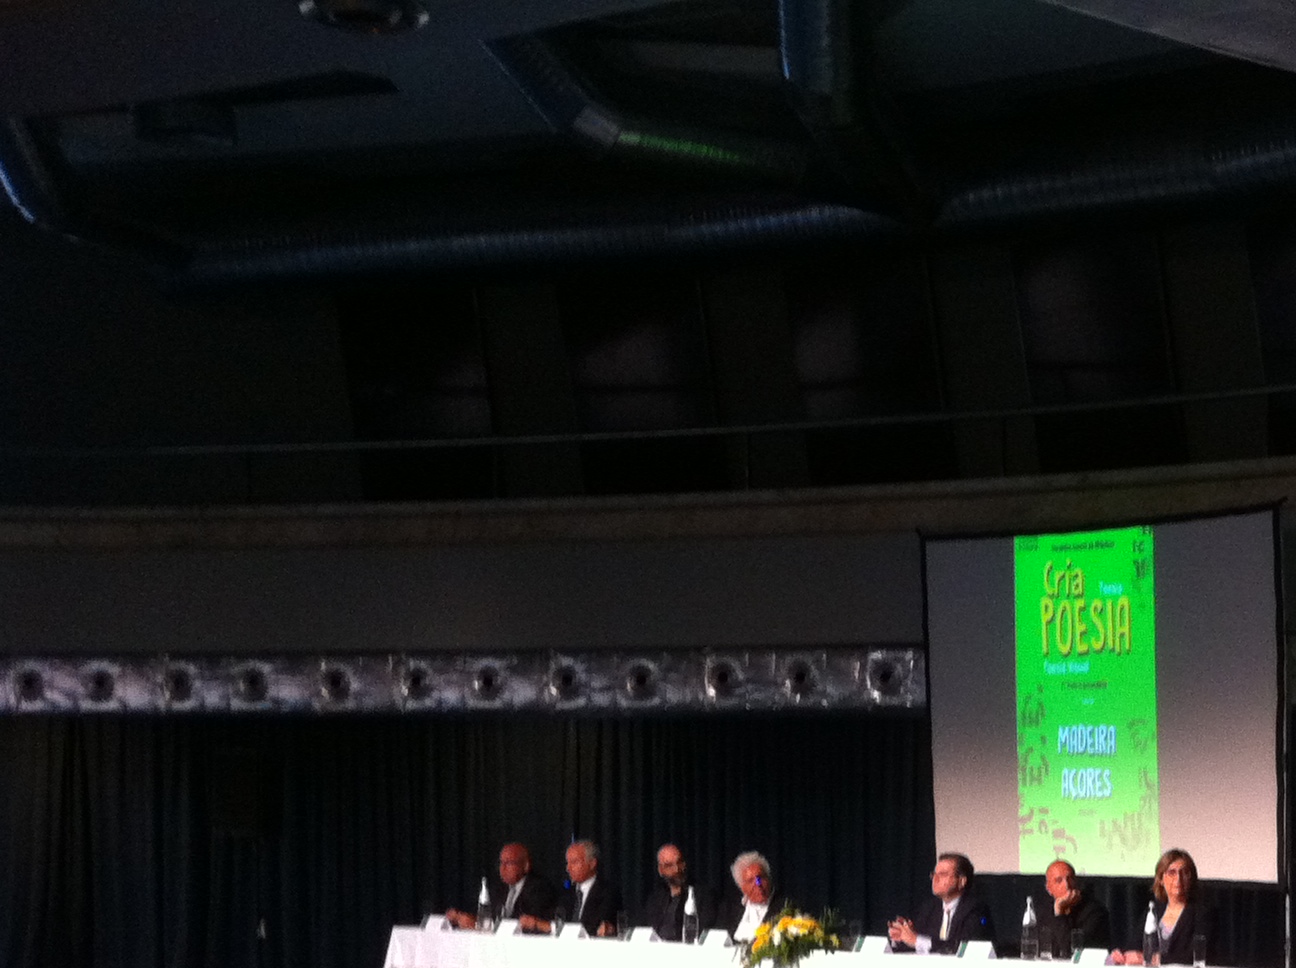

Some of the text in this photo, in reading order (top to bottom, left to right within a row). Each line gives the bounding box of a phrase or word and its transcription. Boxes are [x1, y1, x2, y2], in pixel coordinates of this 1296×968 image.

[1043, 557, 1086, 600] Cria
[1040, 596, 1132, 657] POESIA
[1057, 724, 1117, 757] MADEIRA
[1061, 767, 1114, 801] AÇORES
